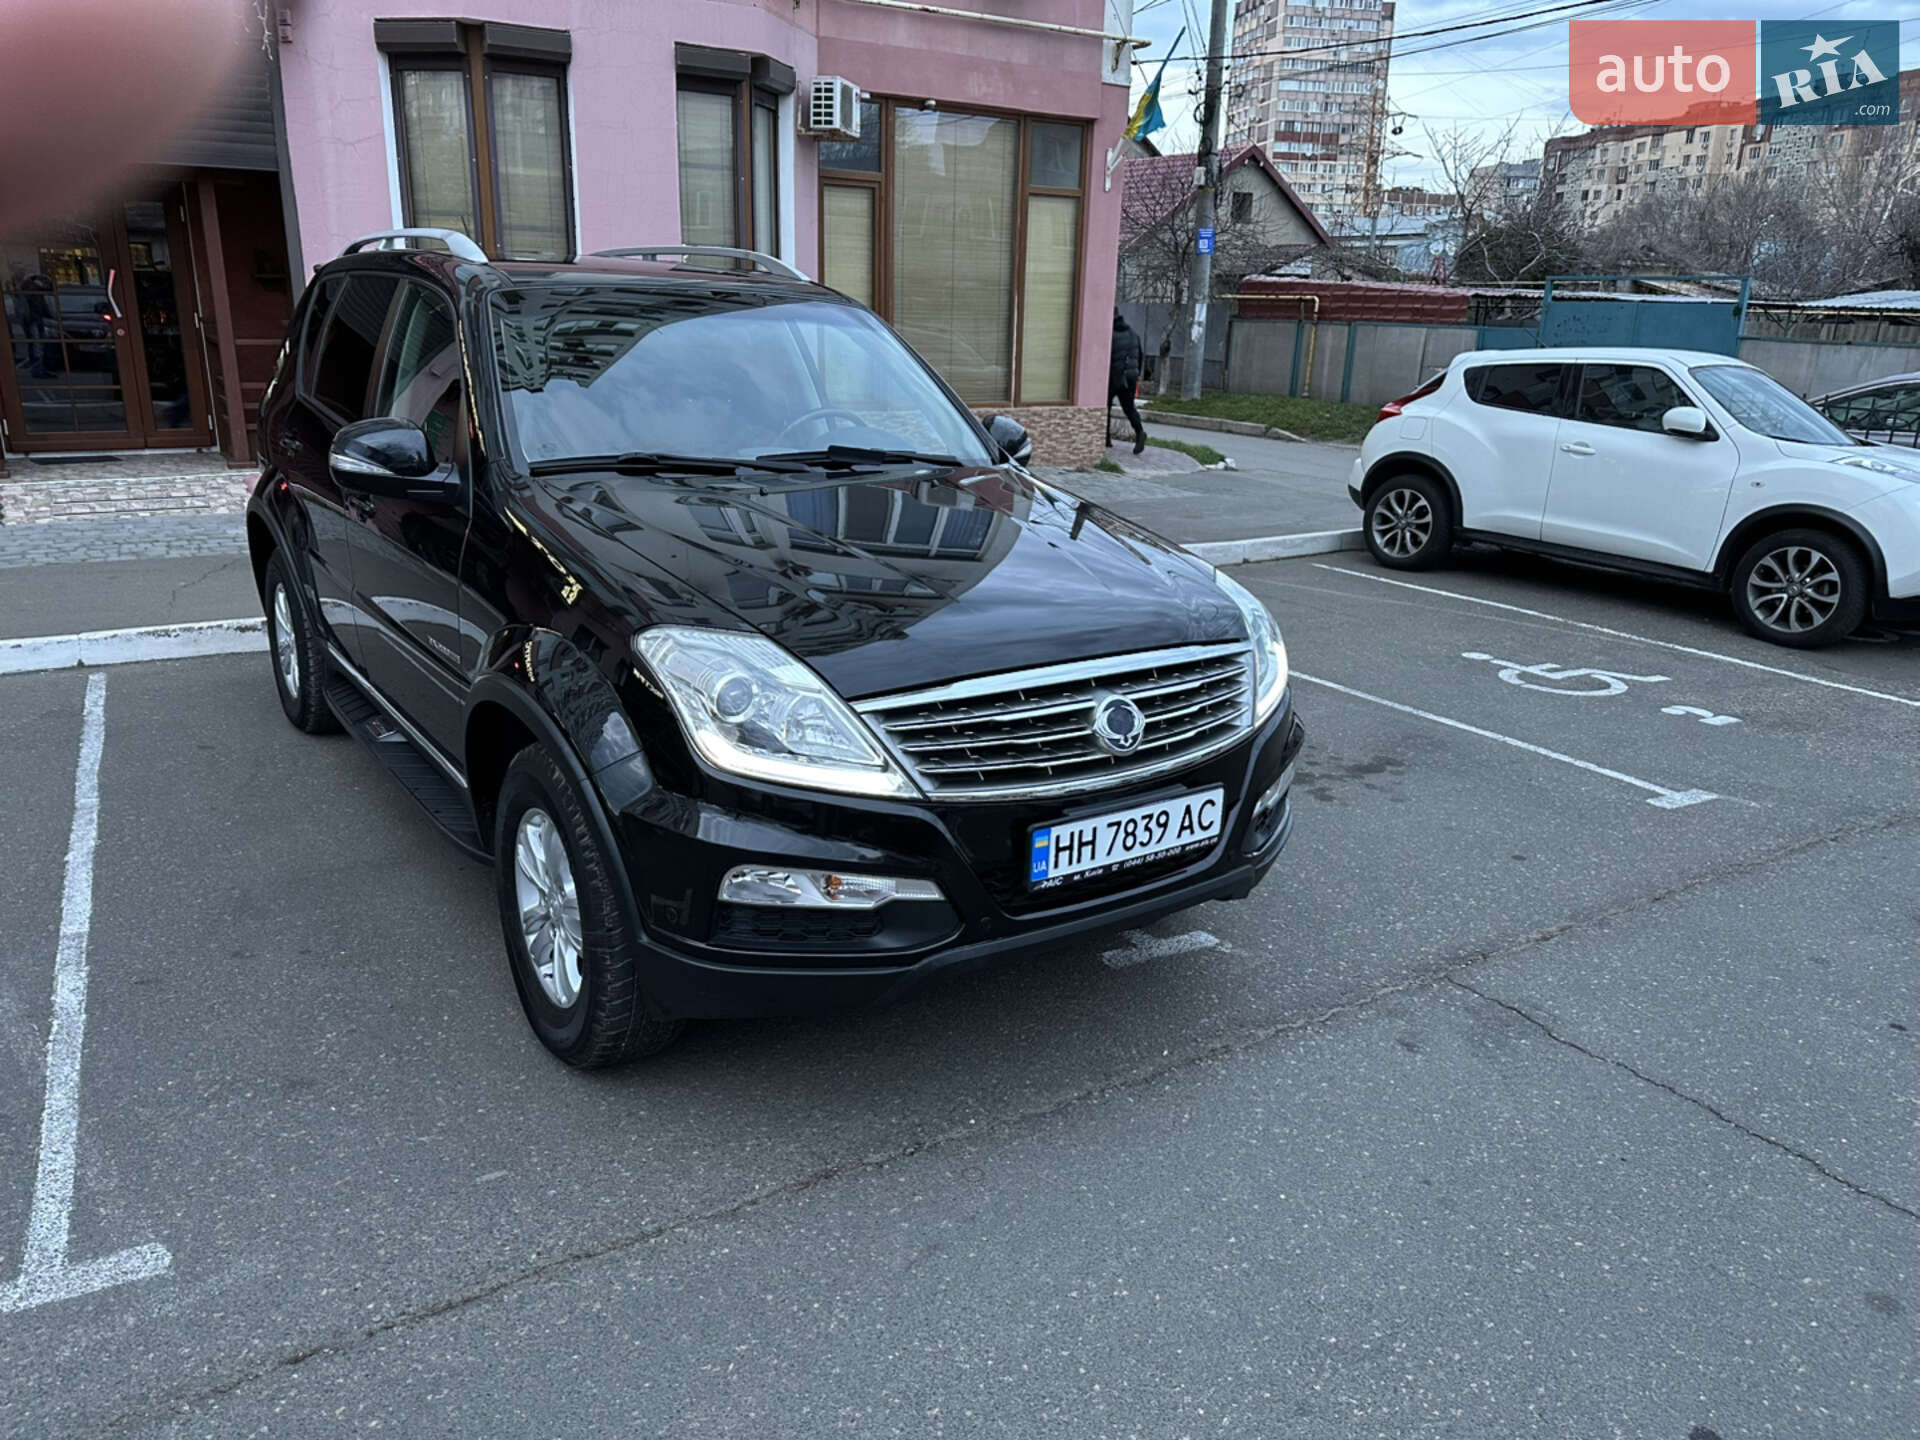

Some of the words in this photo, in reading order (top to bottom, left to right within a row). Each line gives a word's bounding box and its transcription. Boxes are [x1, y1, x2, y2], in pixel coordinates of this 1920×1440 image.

[1053, 826, 1097, 870] HH
[1106, 810, 1169, 857] 7839
[1176, 799, 1216, 839] AC
[1033, 860, 1048, 873] UA
